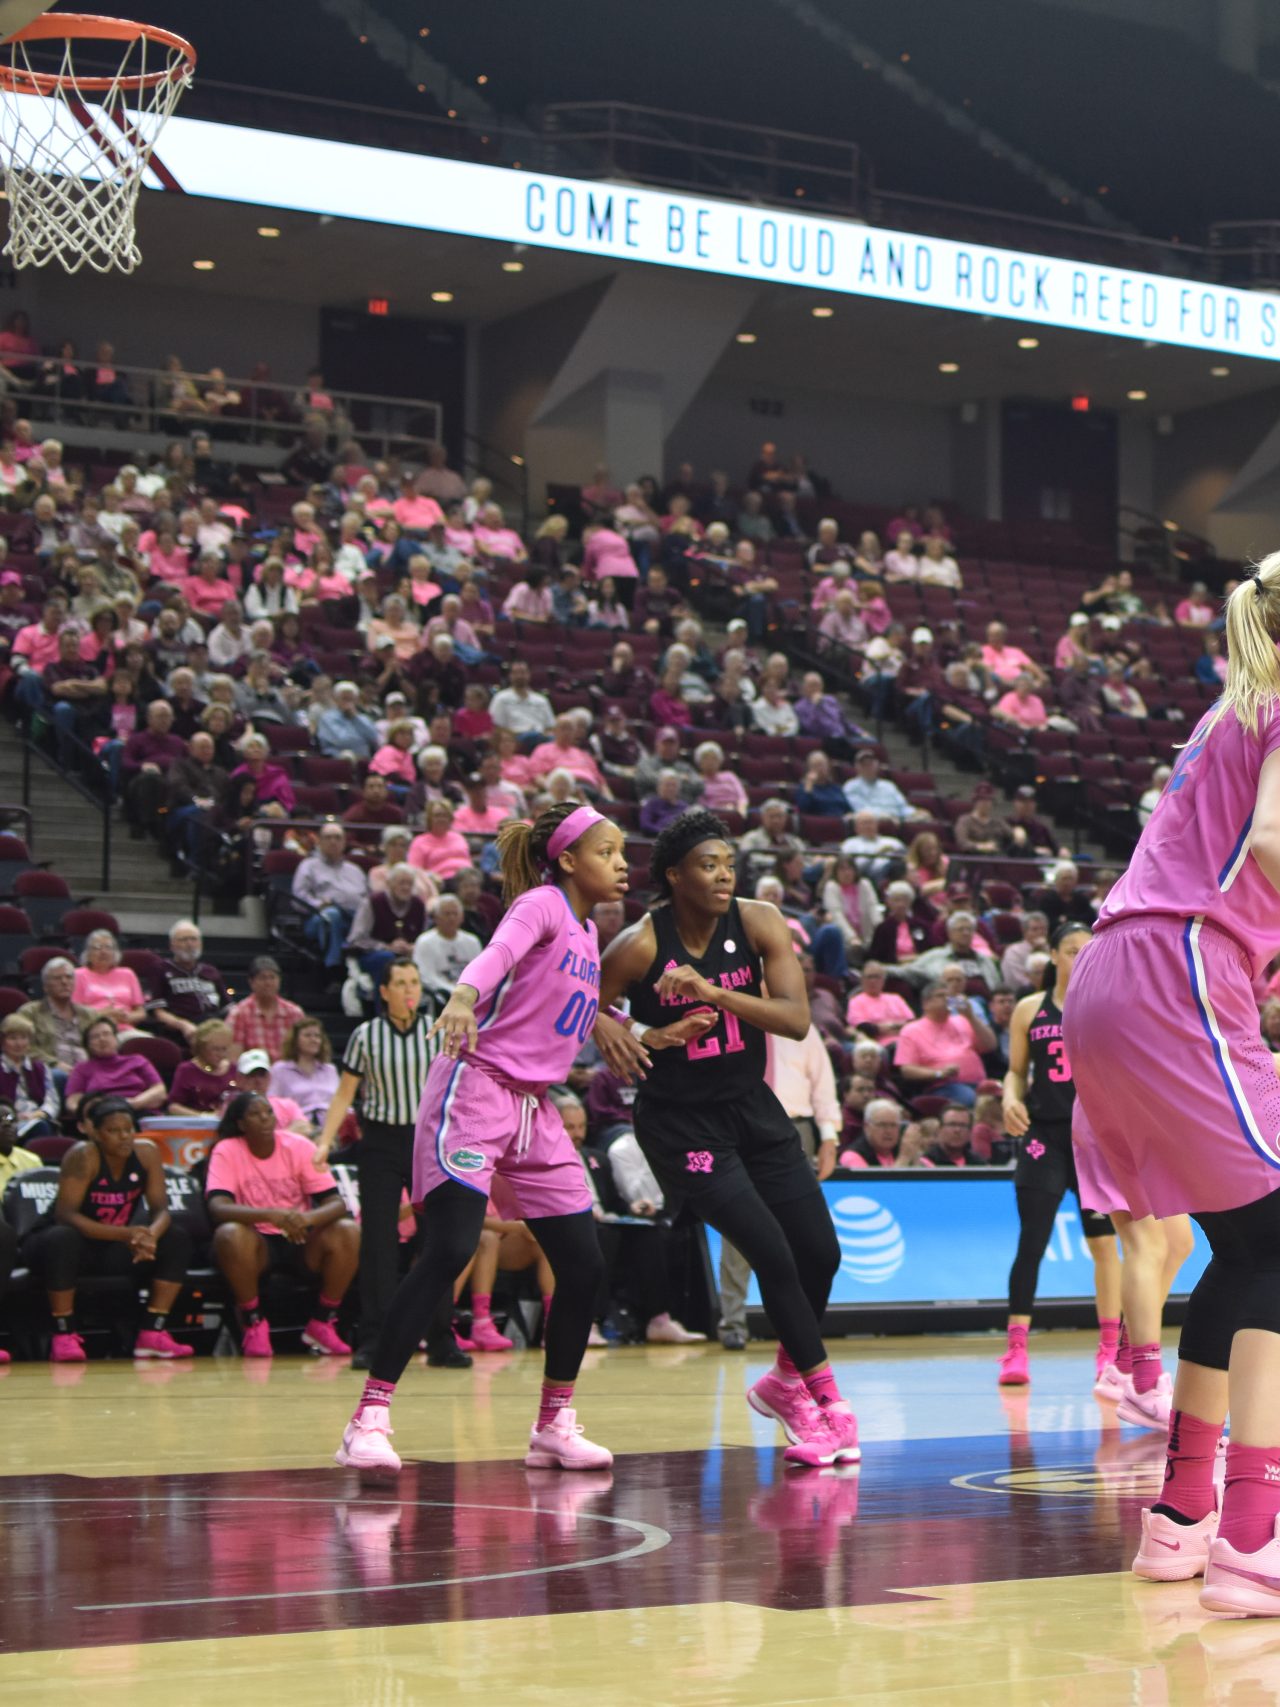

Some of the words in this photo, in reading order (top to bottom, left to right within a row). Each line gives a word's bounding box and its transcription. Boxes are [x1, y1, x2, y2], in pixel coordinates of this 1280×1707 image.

[526, 182, 639, 247] COME
[667, 204, 710, 258] BE
[737, 215, 835, 277] LOUD
[859, 236, 932, 292] AND
[955, 252, 1050, 312] ROCK
[1072, 271, 1158, 328] REED
[1180, 289, 1240, 342] FOR
[559, 948, 602, 989] FLOR
[719, 965, 753, 991] A&M
[554, 990, 598, 1044] 00
[681, 1005, 746, 1061] 21
[1047, 1041, 1072, 1082] 3
